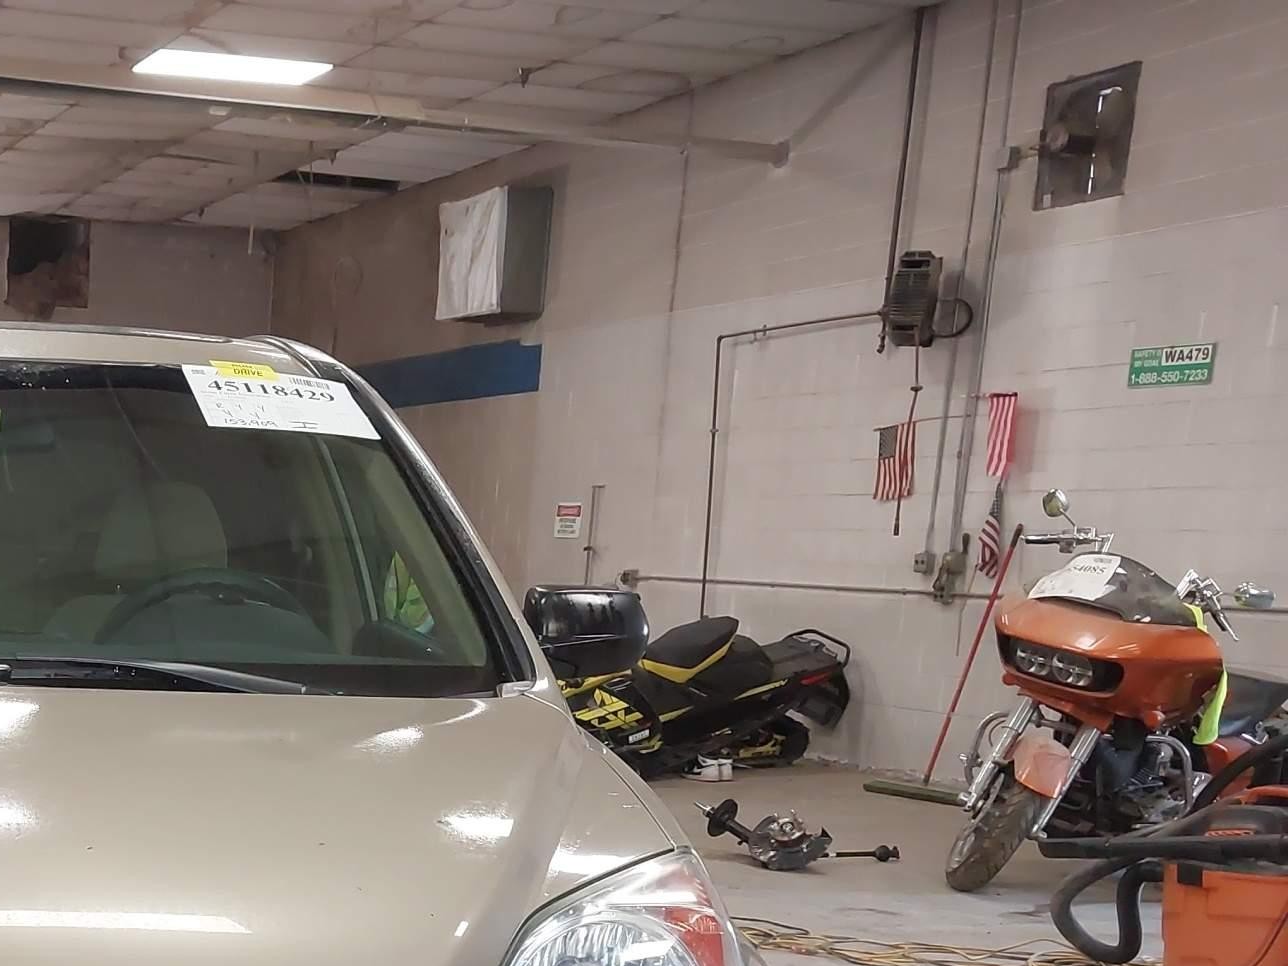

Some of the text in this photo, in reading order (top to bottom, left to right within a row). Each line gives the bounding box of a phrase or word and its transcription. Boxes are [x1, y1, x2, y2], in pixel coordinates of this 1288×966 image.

[1165, 346, 1210, 363] WA479
[233, 368, 264, 377] DRIVE
[1131, 369, 1208, 384] 1-888-550-7233
[207, 379, 335, 402] 45118429
